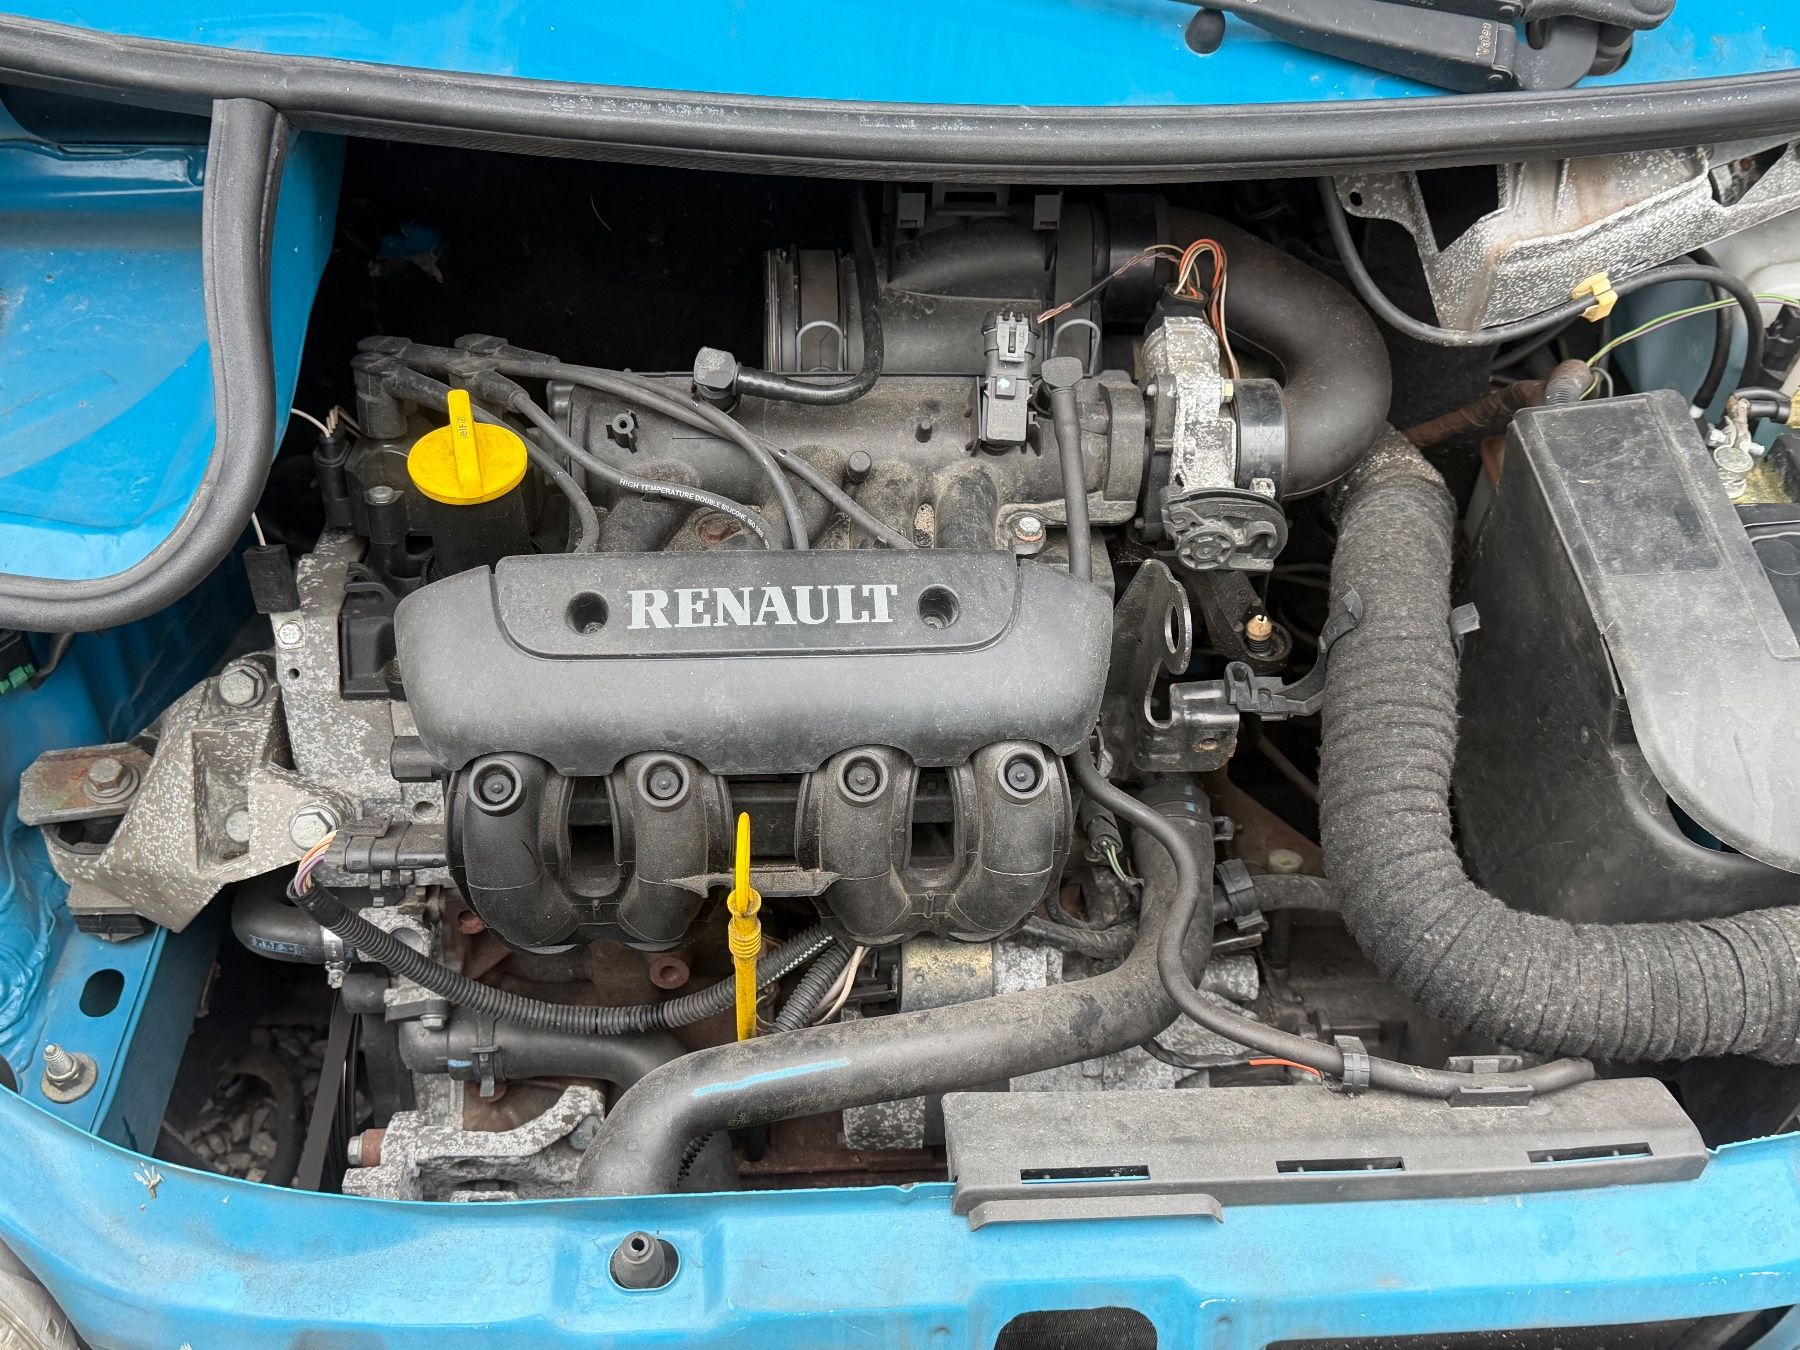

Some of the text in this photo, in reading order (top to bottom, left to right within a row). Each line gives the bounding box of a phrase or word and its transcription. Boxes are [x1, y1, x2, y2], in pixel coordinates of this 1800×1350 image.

[1476, 22, 1492, 56] Valeo
[619, 478, 639, 489] HIGH
[641, 484, 694, 500] TEMPERATURE
[694, 494, 722, 509] DOUBLE
[721, 503, 747, 522] SILICONE
[627, 584, 898, 629] RENAULT
